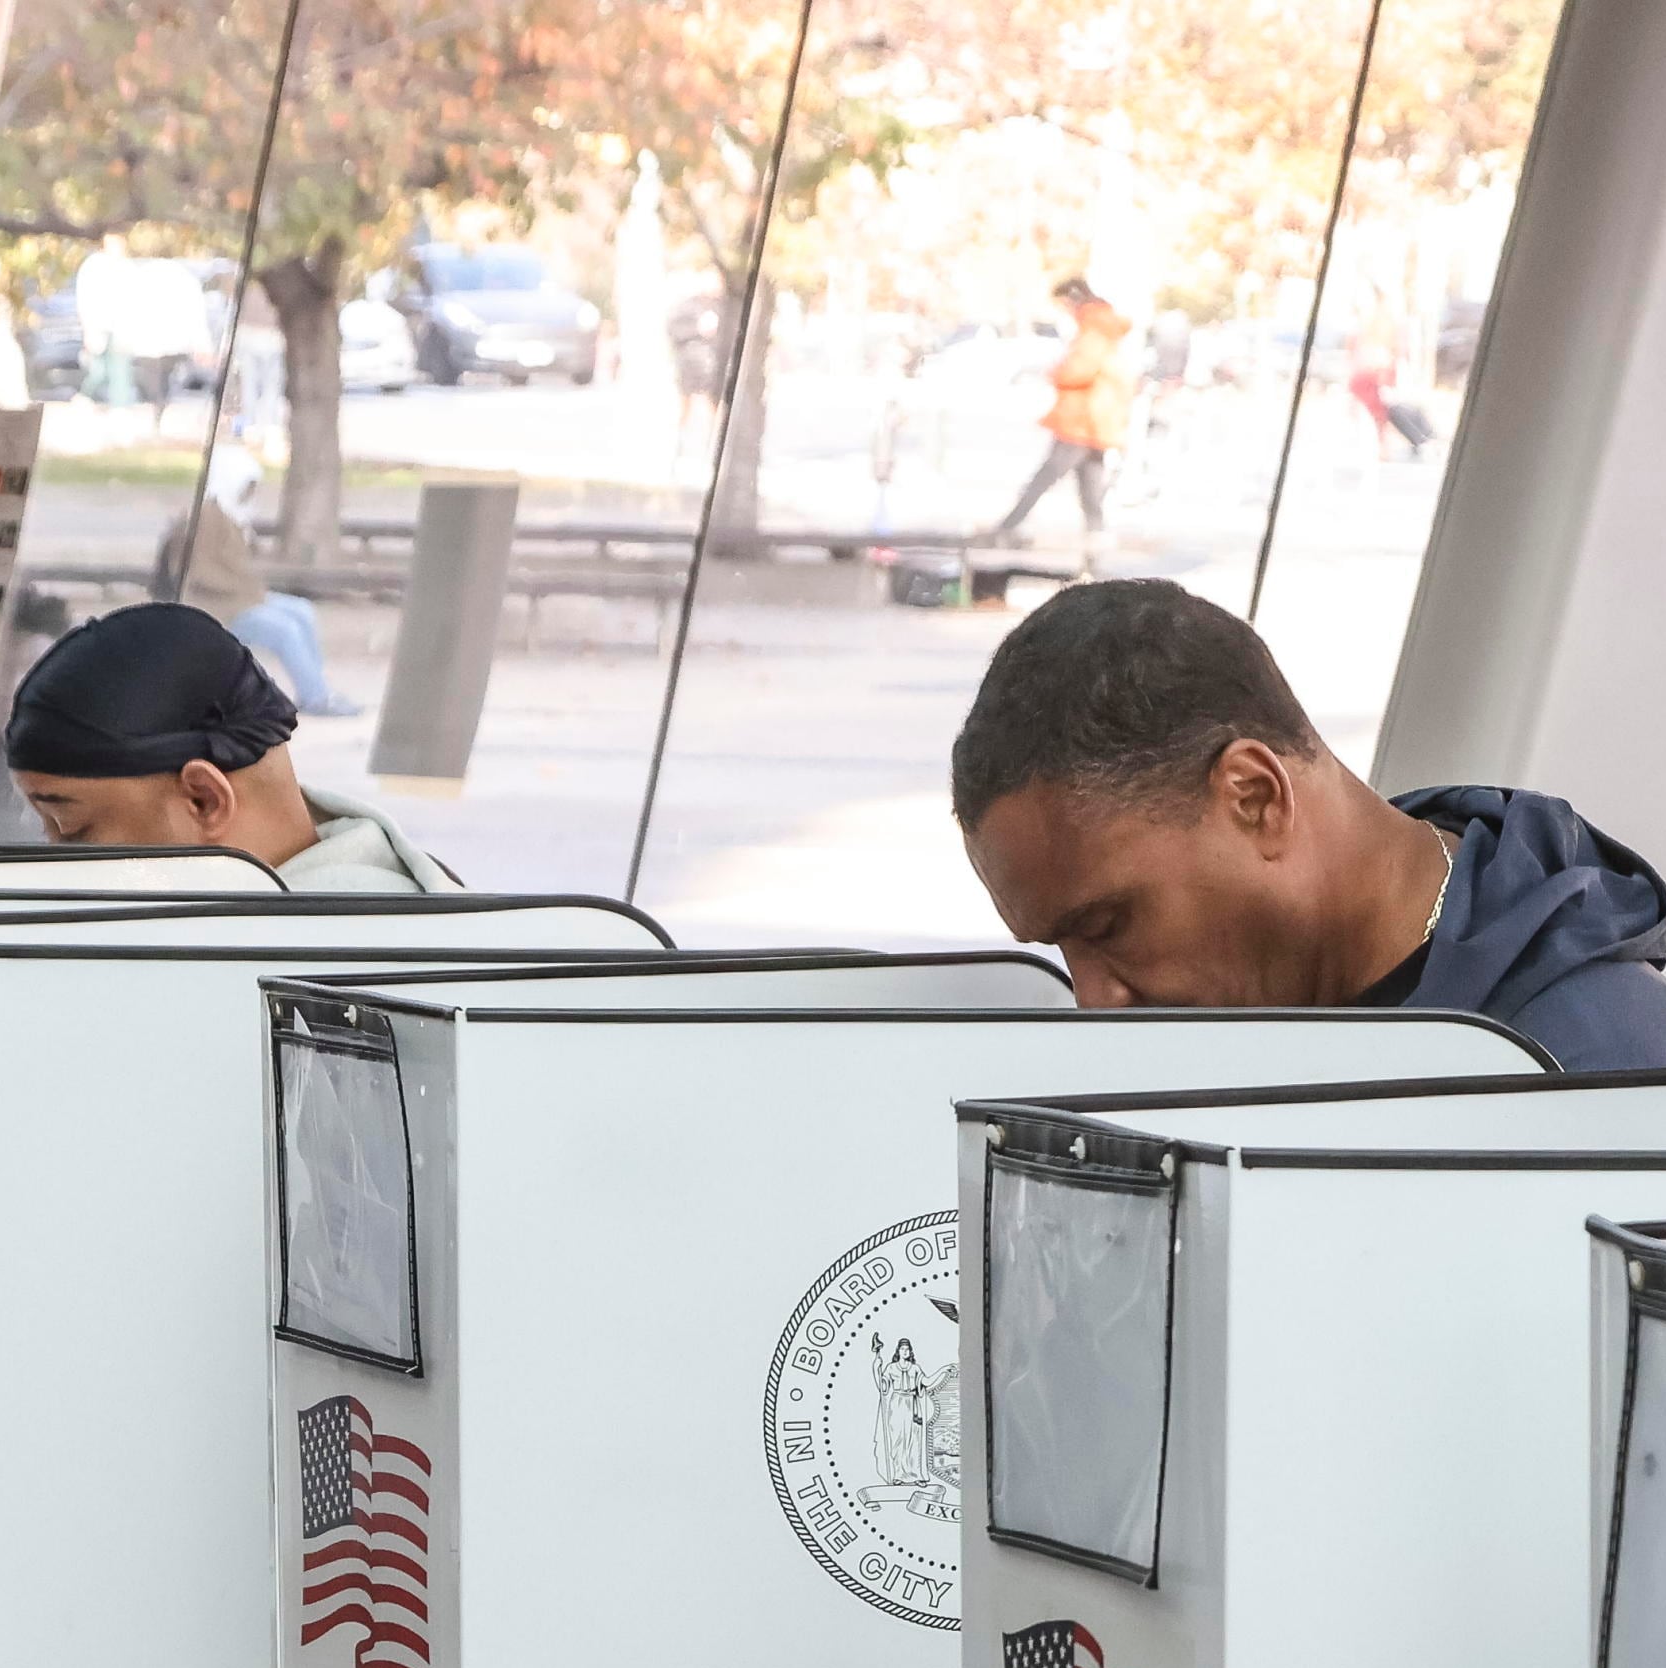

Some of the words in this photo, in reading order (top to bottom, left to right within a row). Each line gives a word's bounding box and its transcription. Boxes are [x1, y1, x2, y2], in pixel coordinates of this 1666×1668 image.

[791, 1256, 893, 1375] BOARD
[905, 1230, 956, 1266] OF
[784, 1421, 814, 1463] IN
[797, 1475, 857, 1553] THE
[859, 1552, 953, 1607] CITY
